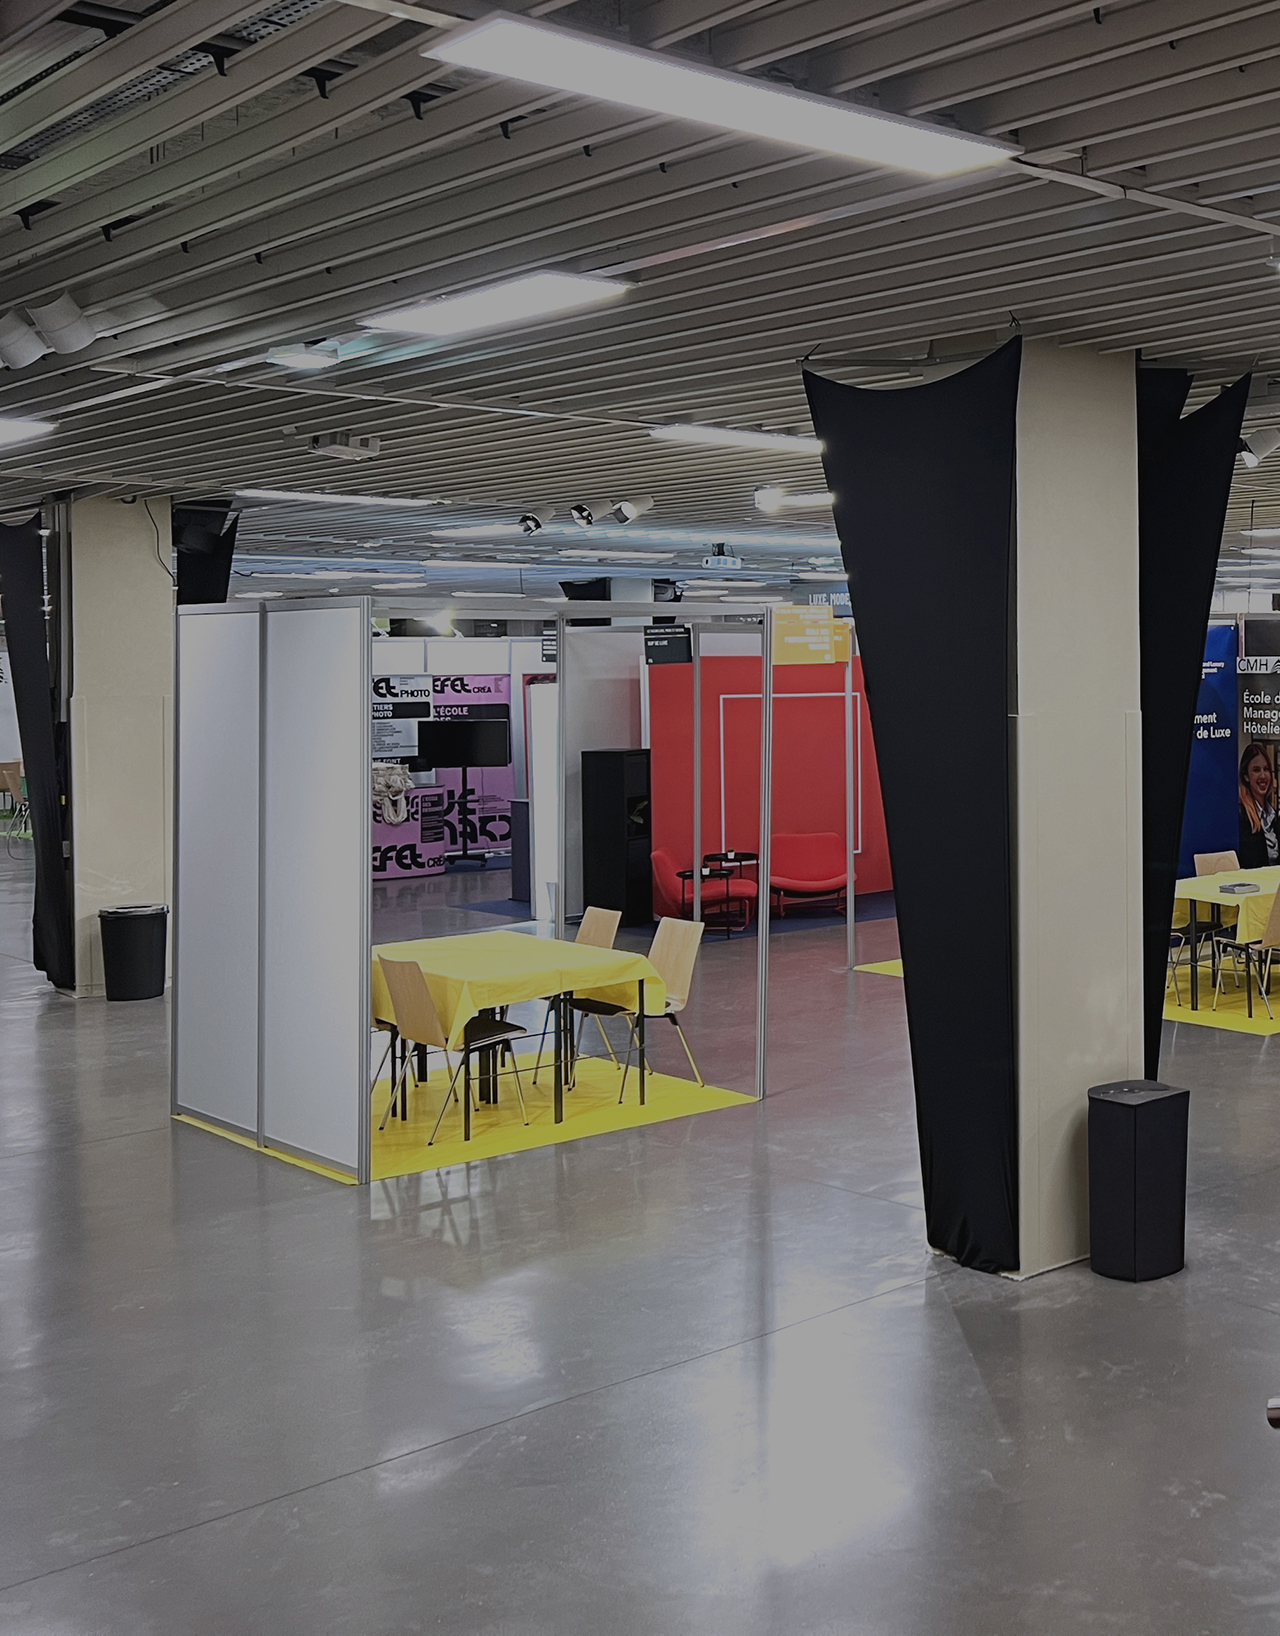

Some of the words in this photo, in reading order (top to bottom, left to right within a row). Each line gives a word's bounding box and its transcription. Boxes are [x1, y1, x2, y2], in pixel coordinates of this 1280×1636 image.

[1238, 659, 1268, 672] CMH
[400, 689, 430, 698] PHOTO
[1243, 689, 1271, 704] École
[1194, 712, 1217, 724] ment
[1196, 727, 1208, 739] de
[1210, 726, 1231, 739] Luxe
